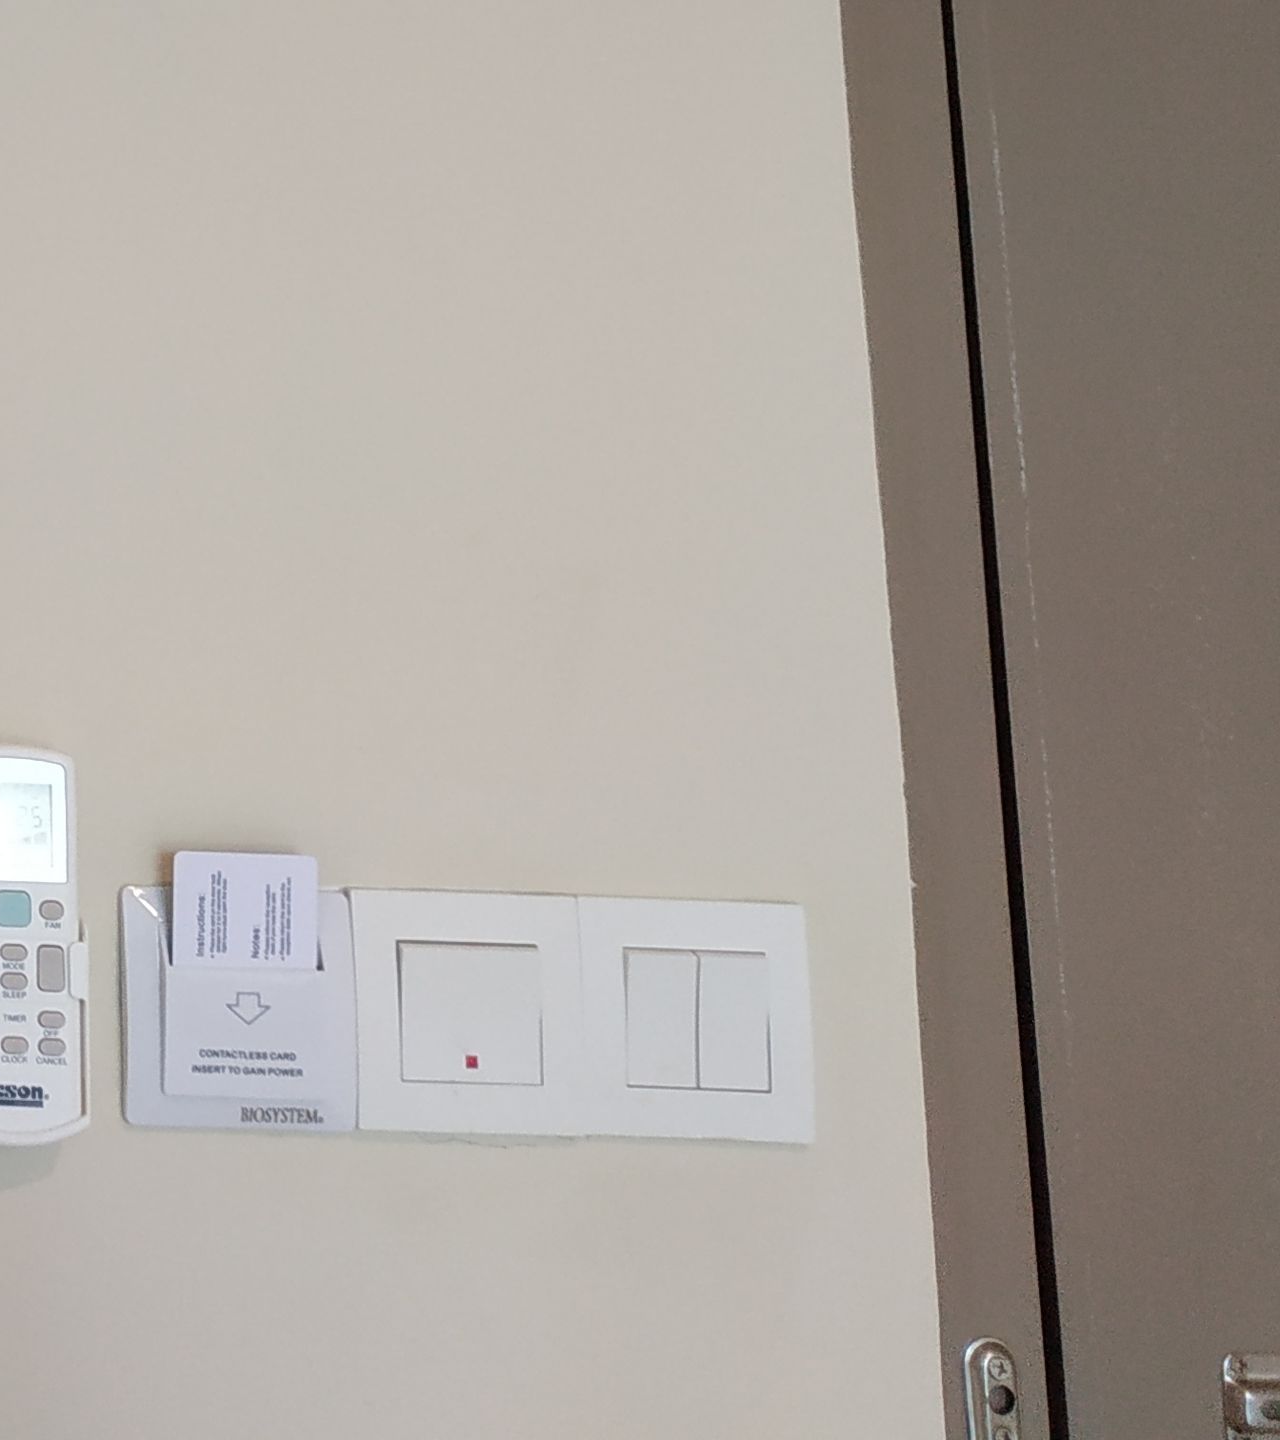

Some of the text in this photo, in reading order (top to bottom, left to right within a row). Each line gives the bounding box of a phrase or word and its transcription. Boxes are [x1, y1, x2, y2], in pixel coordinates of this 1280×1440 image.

[44, 921, 62, 929] FAN
[1, 962, 26, 970] MODE
[1, 990, 27, 999] SLEEP
[3, 1013, 27, 1022] TIMER
[42, 1029, 59, 1037] OFF
[0, 1055, 29, 1064] CLOCK
[198, 1048, 297, 1062] CONTACTLESS CARD
[35, 1056, 68, 1066] CANCEL
[191, 1064, 304, 1078] INSERT TO GAIN POWER
[240, 1106, 319, 1124] BIOSYSTEM
